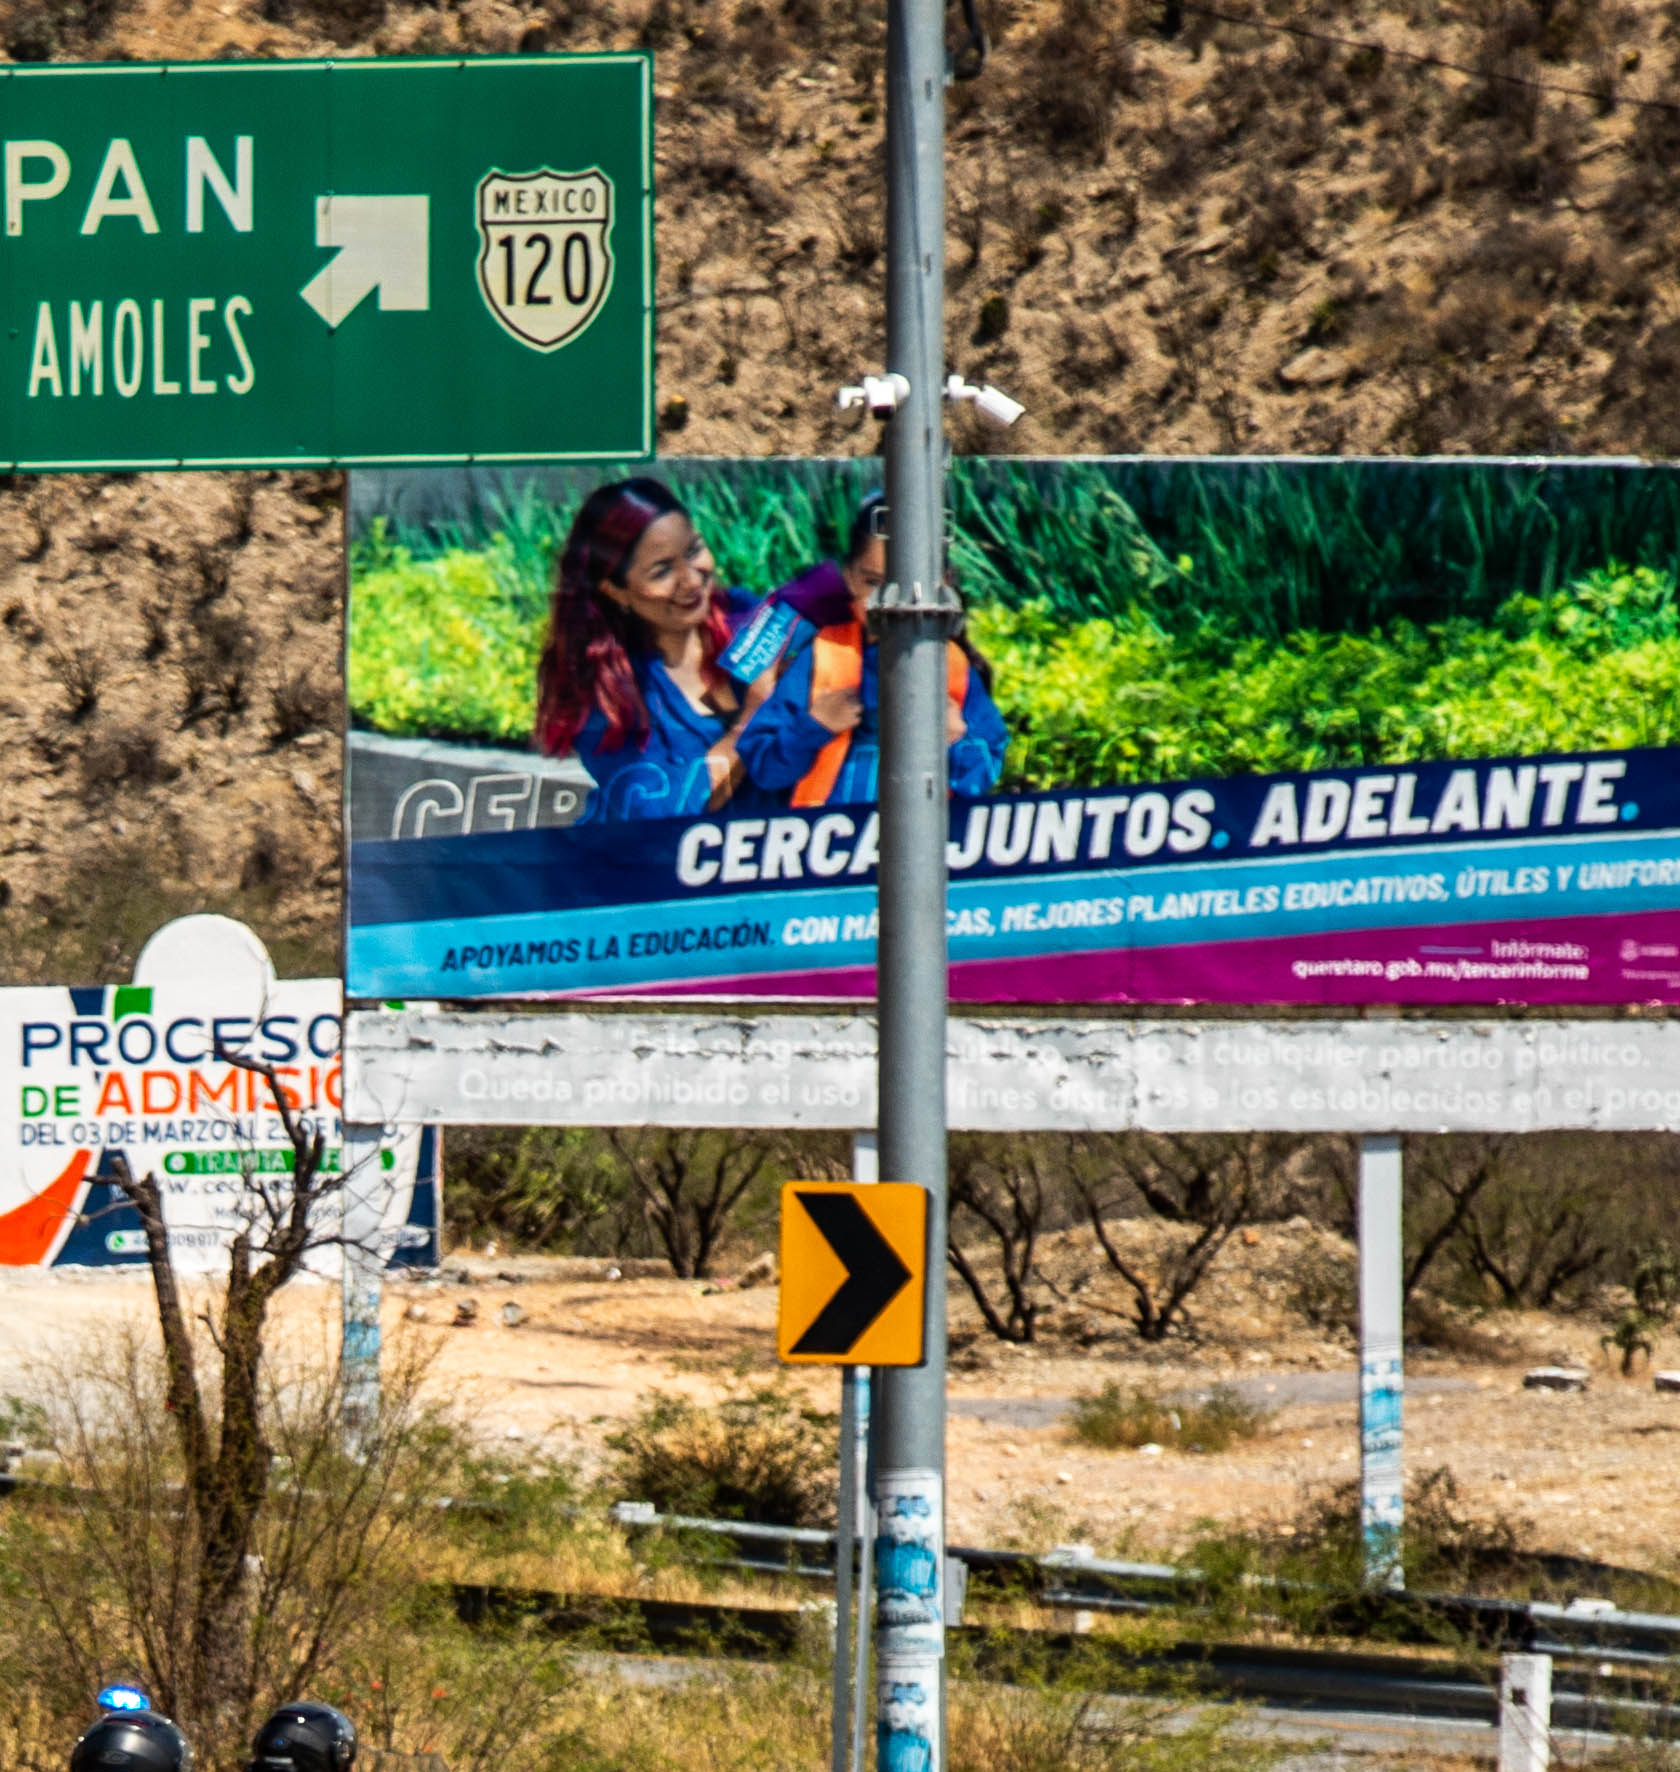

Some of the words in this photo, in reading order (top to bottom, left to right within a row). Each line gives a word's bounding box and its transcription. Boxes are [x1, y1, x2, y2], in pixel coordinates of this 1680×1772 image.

[493, 187, 597, 215] MEXICO
[497, 231, 592, 307] 120
[27, 296, 255, 398] AMOLES
[946, 790, 1230, 871] JUNTOS.
[1247, 759, 1639, 848] ADELANTE.
[441, 938, 581, 972] APOYAMOS
[586, 935, 620, 961] LA
[627, 917, 775, 960] EDUCACIÓN.
[782, 915, 839, 945] CON
[1000, 896, 1126, 934] MEJORES
[1126, 884, 1280, 923] PLANTELES
[1282, 872, 1450, 912] EDUCATIVOS,
[1454, 865, 1551, 899] ÚTILES
[1555, 864, 1575, 892] Y
[21, 1014, 342, 1066] PROCESO
[20, 1122, 65, 1147] DEL
[71, 1121, 100, 1146] 03
[108, 1121, 137, 1145] DE
[143, 1119, 230, 1143] MARZO
[21, 1085, 81, 1117] DE
